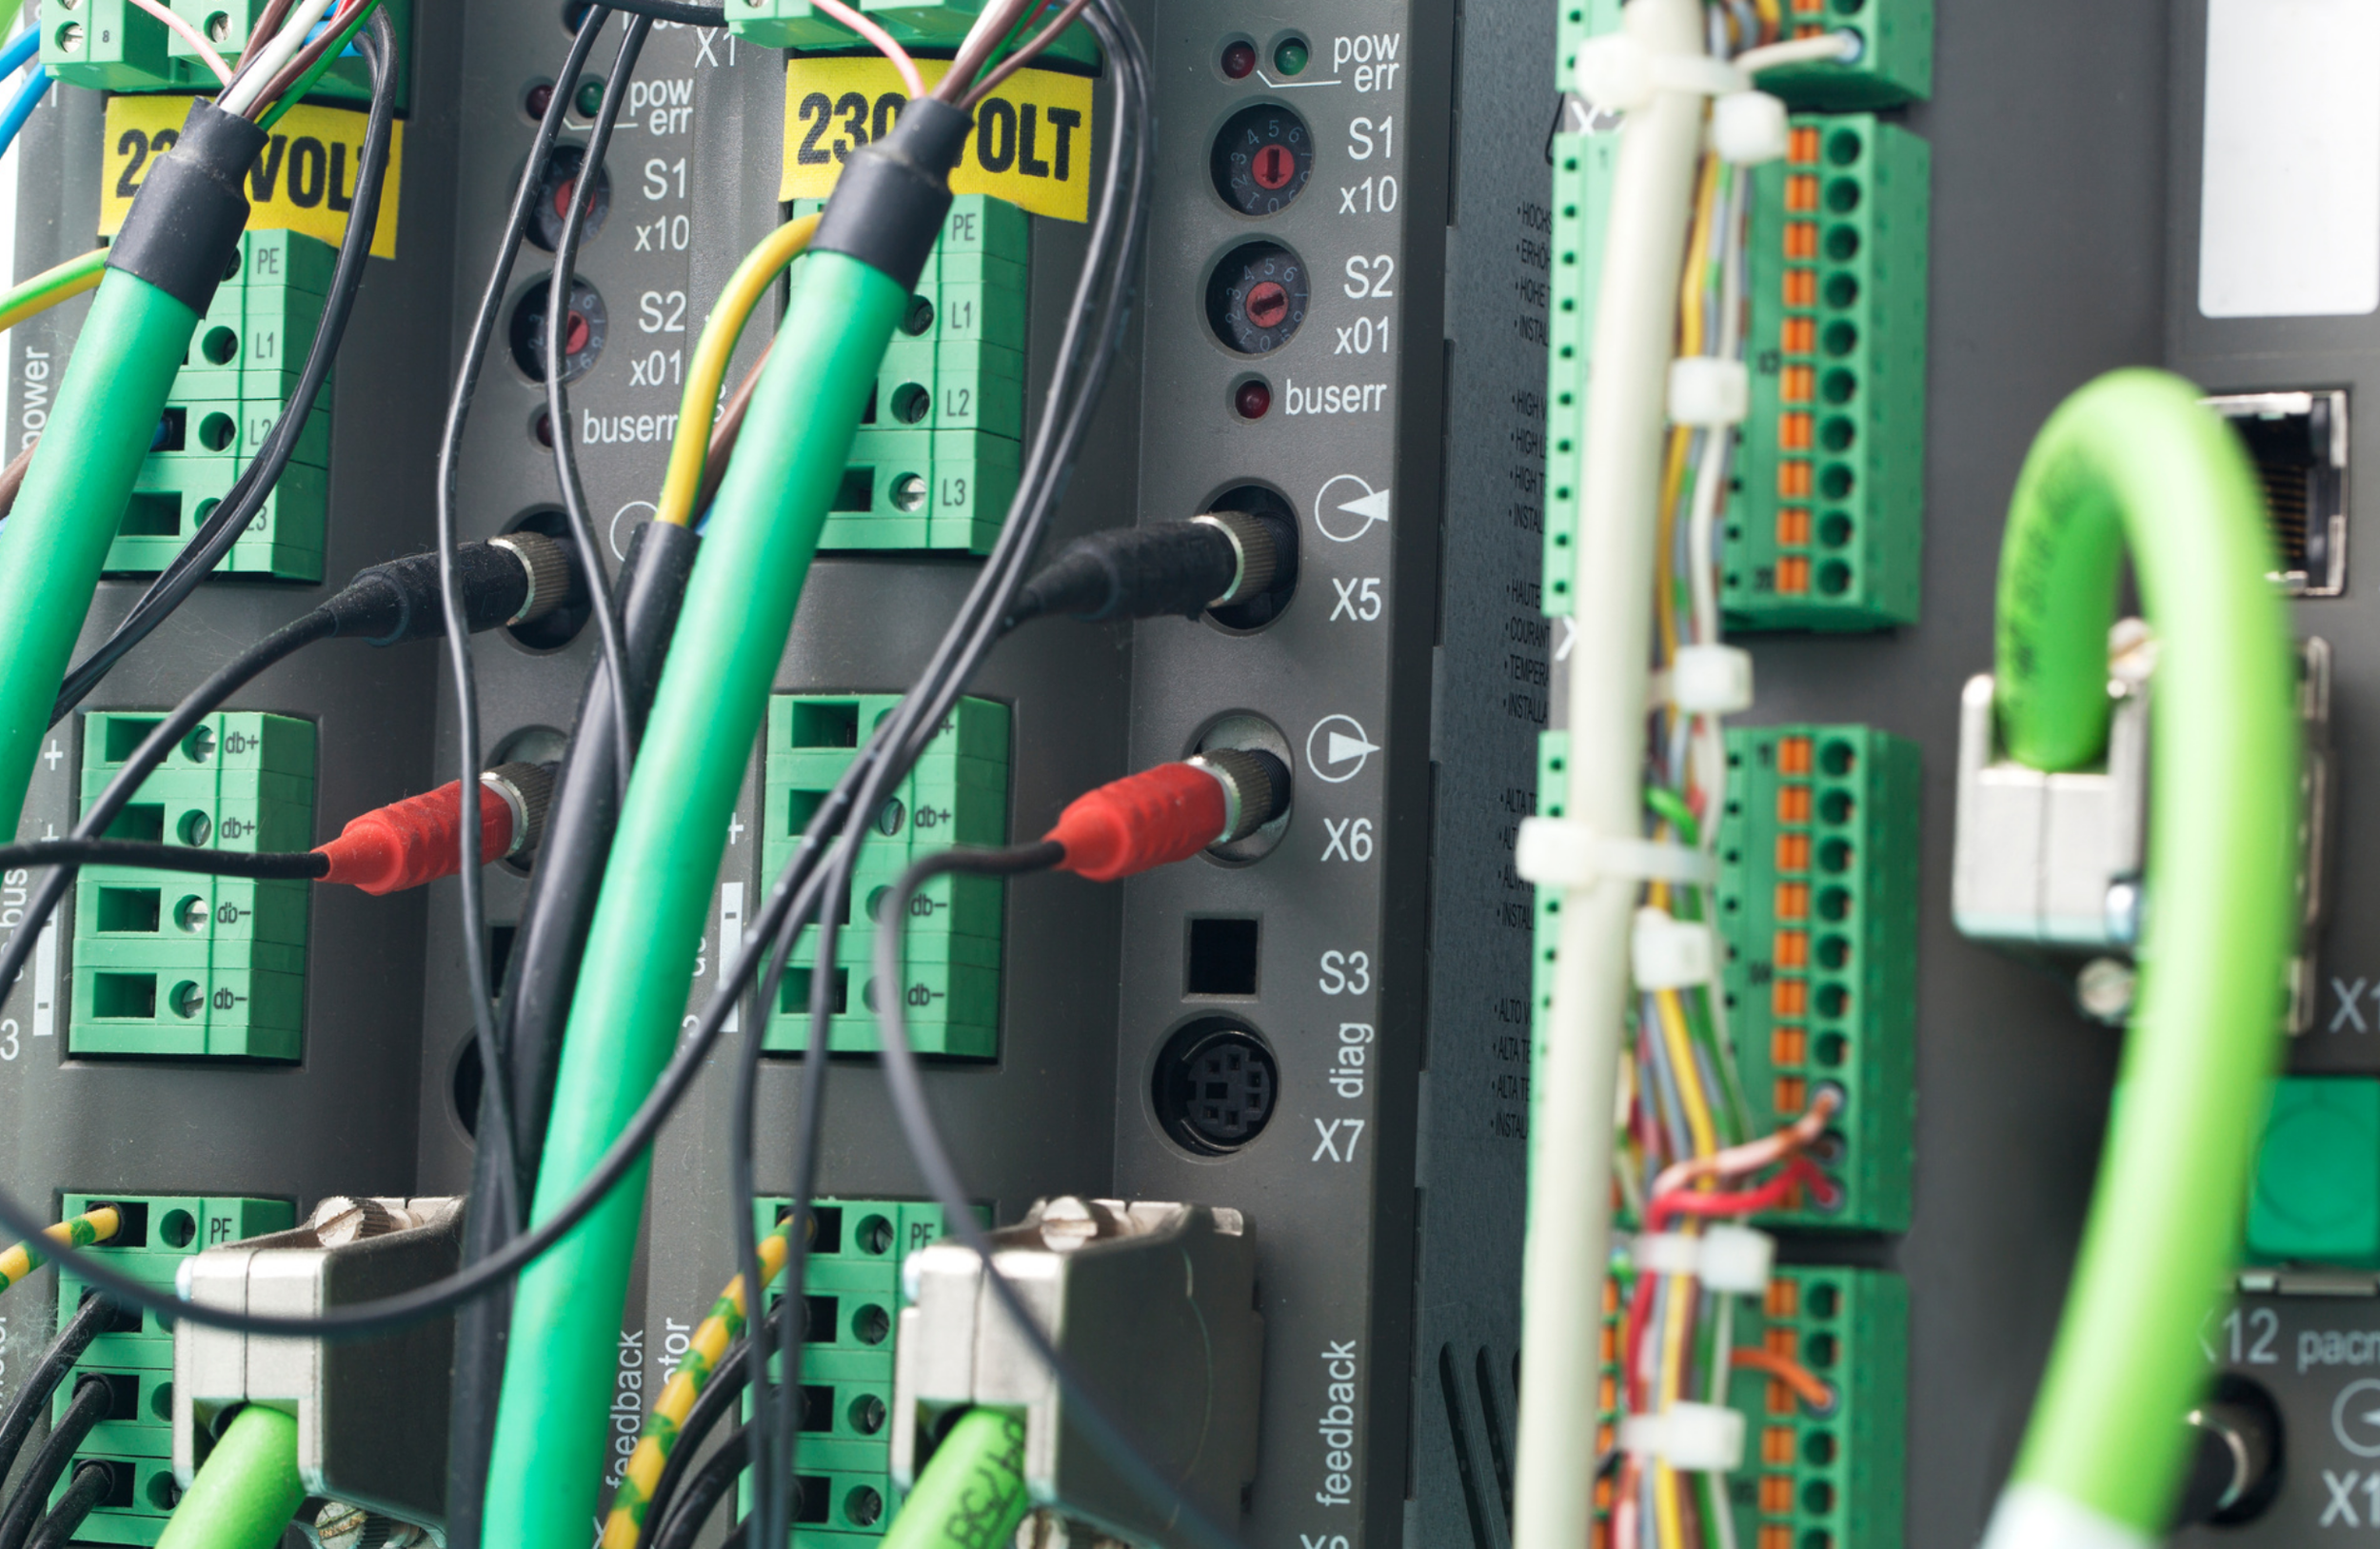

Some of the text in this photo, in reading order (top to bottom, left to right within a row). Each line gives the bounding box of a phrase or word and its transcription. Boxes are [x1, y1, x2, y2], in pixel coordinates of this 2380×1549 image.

[102, 30, 110, 44] 8
[1334, 33, 1399, 72] pow
[1354, 63, 1399, 92] err
[630, 78, 693, 116] pow
[649, 107, 693, 135] err
[952, 97, 1081, 182] OLT
[1348, 116, 1393, 160] S1
[249, 134, 389, 213] VOL
[644, 158, 685, 200] S1
[1339, 175, 1398, 214] x10
[635, 215, 689, 251] x10
[952, 212, 977, 242] PE
[257, 248, 280, 275] PE
[1343, 255, 1395, 299] S2
[639, 291, 686, 332] S2
[951, 301, 971, 329] L1
[255, 332, 274, 359] L1
[1334, 316, 1389, 354] x01
[629, 349, 681, 387] x01
[945, 390, 970, 417] L2
[1286, 379, 1387, 415] buserr
[583, 409, 678, 445] buserr
[942, 479, 966, 506] L3
[1330, 578, 1381, 622] X5
[225, 732, 259, 754] db+
[221, 816, 256, 839] db+
[914, 804, 951, 828] db+
[1321, 818, 1373, 863] X6
[1319, 950, 1370, 996] S3
[1329, 1023, 1374, 1098] diag
[1311, 1119, 1364, 1162] X7
[605, 1329, 644, 1489] feedback
[1316, 1340, 1356, 1506] feedback
